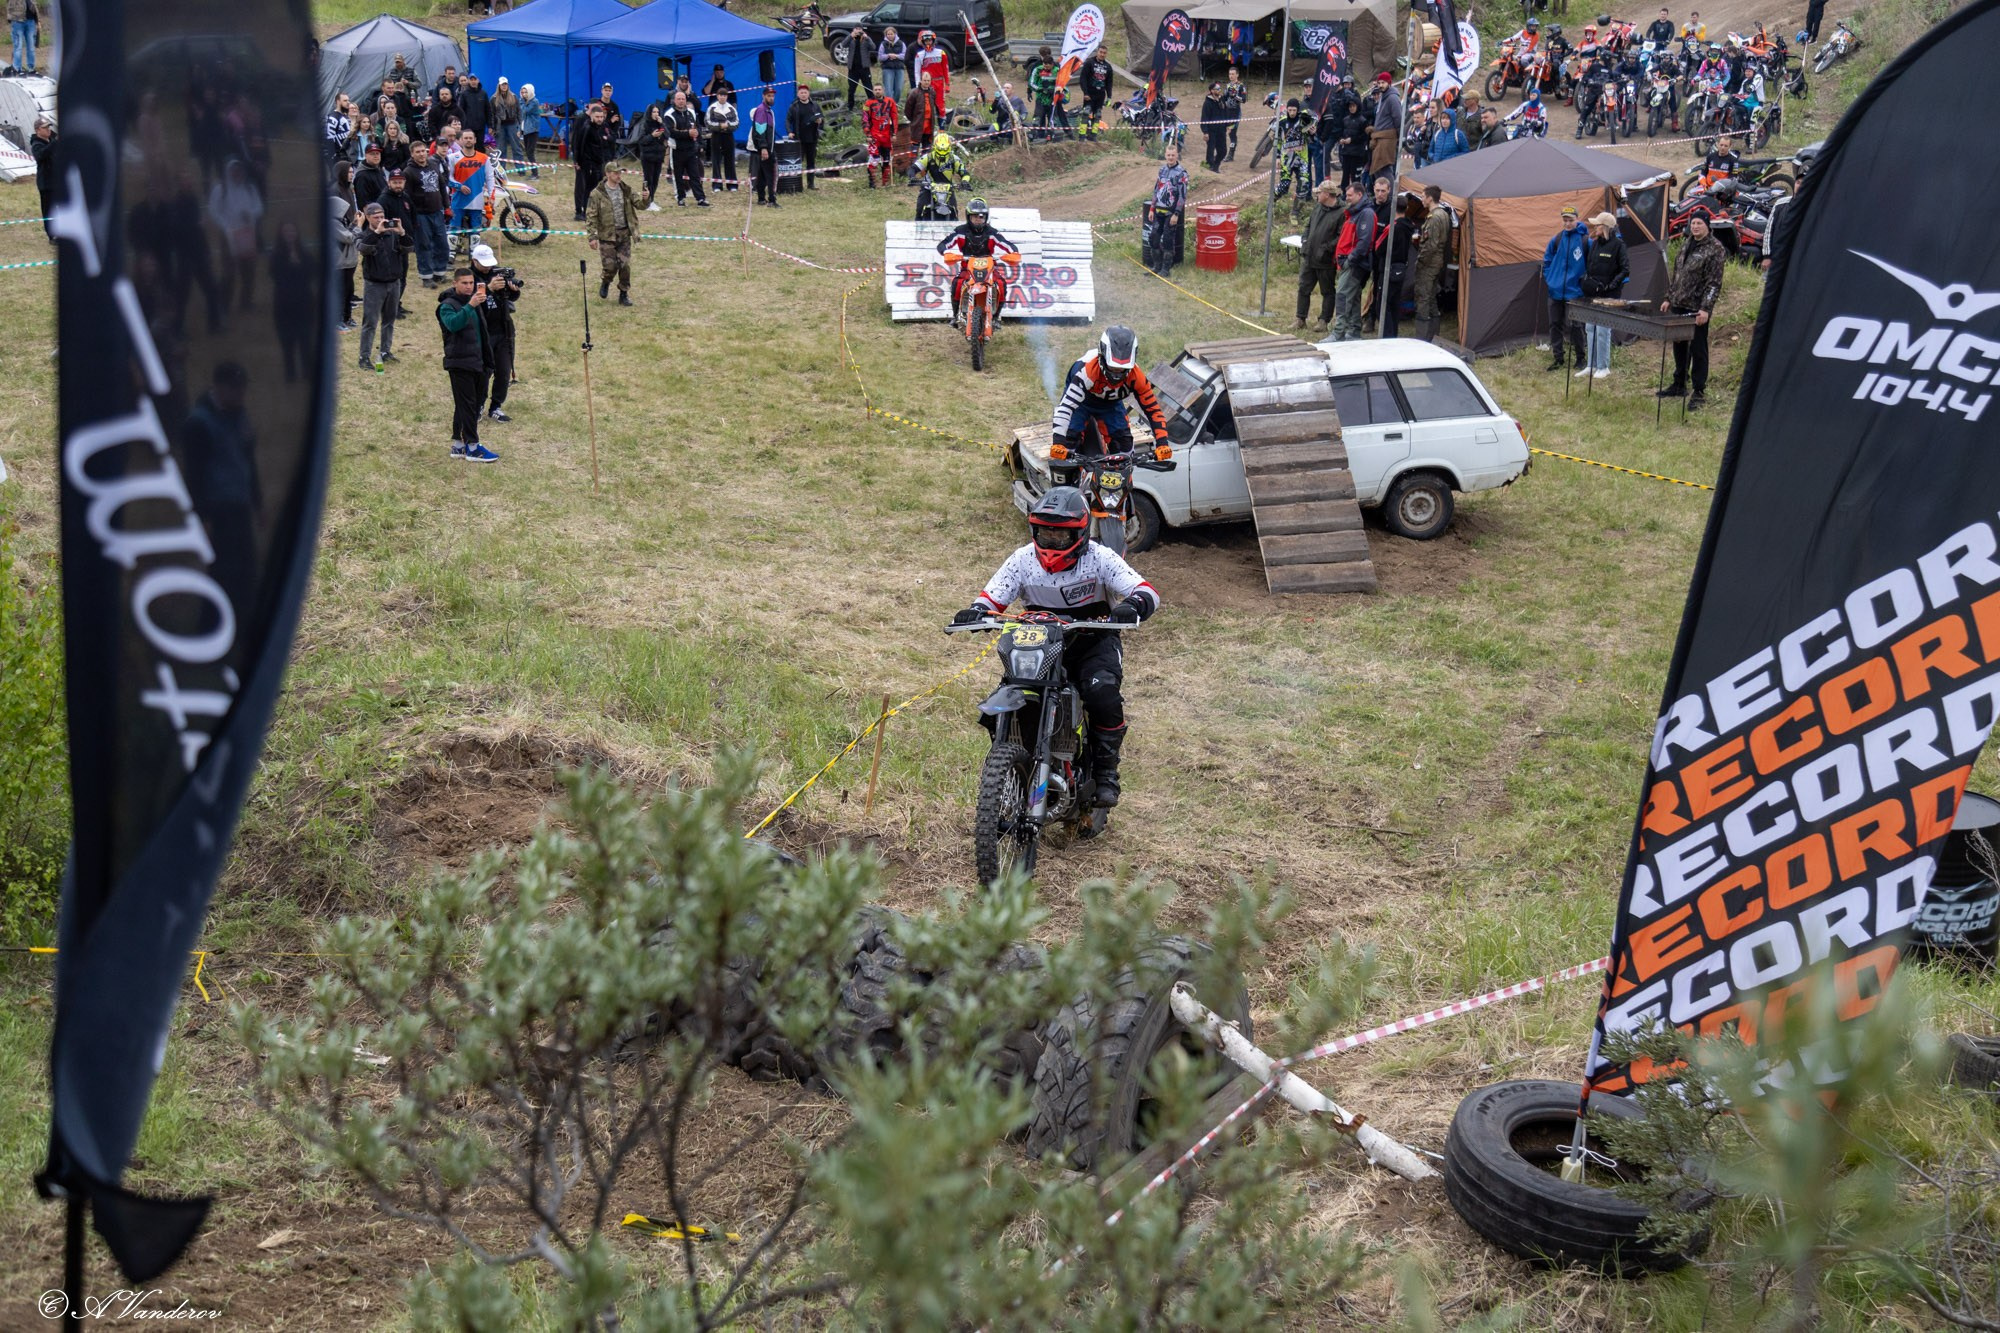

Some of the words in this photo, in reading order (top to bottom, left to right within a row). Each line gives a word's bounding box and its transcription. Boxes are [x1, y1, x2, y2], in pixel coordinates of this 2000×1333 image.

[1162, 13, 1190, 31] ENDURO
[1323, 36, 1346, 60] ENDURO
[458, 160, 483, 169] KTM
[895, 262, 1078, 289] ENURO
[1020, 631, 1037, 642] 38
[1650, 512, 2000, 773] RECOR
[1947, 917, 1991, 933] RADIO
